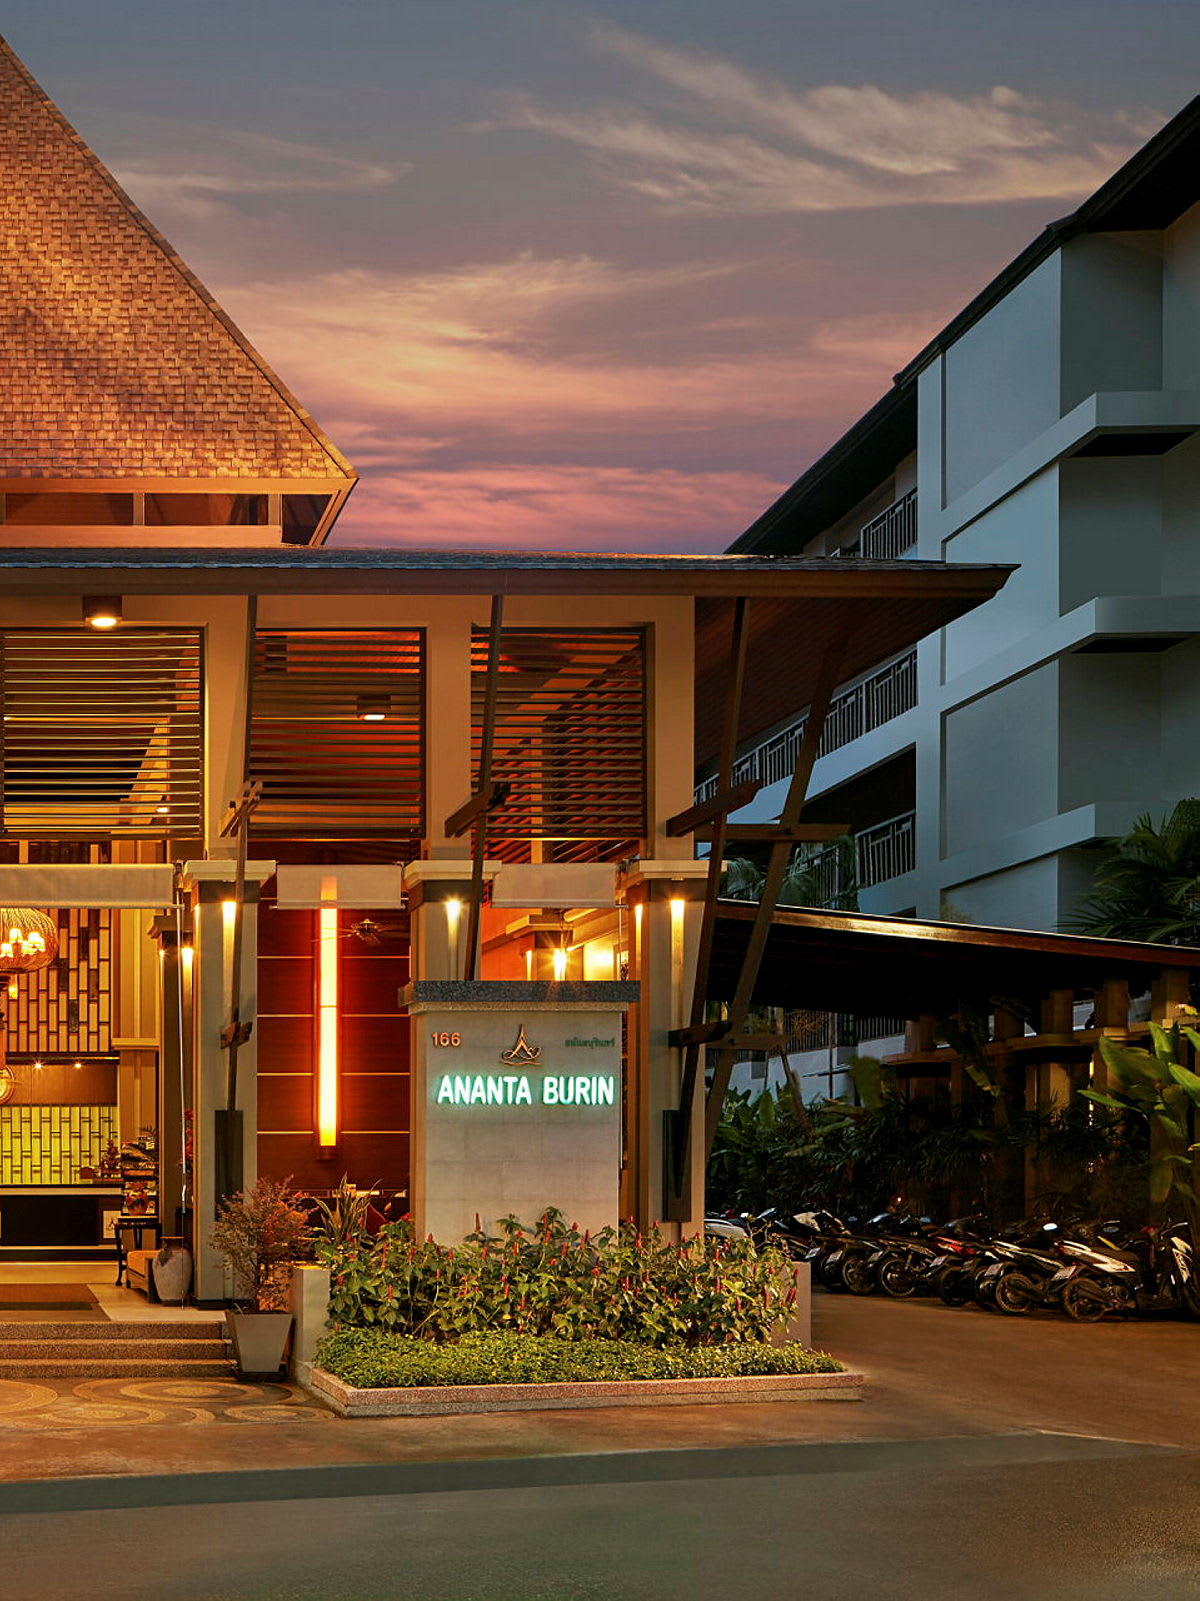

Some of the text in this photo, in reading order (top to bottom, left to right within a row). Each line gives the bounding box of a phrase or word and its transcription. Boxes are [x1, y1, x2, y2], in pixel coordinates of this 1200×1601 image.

[431, 1031, 462, 1048] 166
[437, 1075, 614, 1105] ANANTA BURIN
